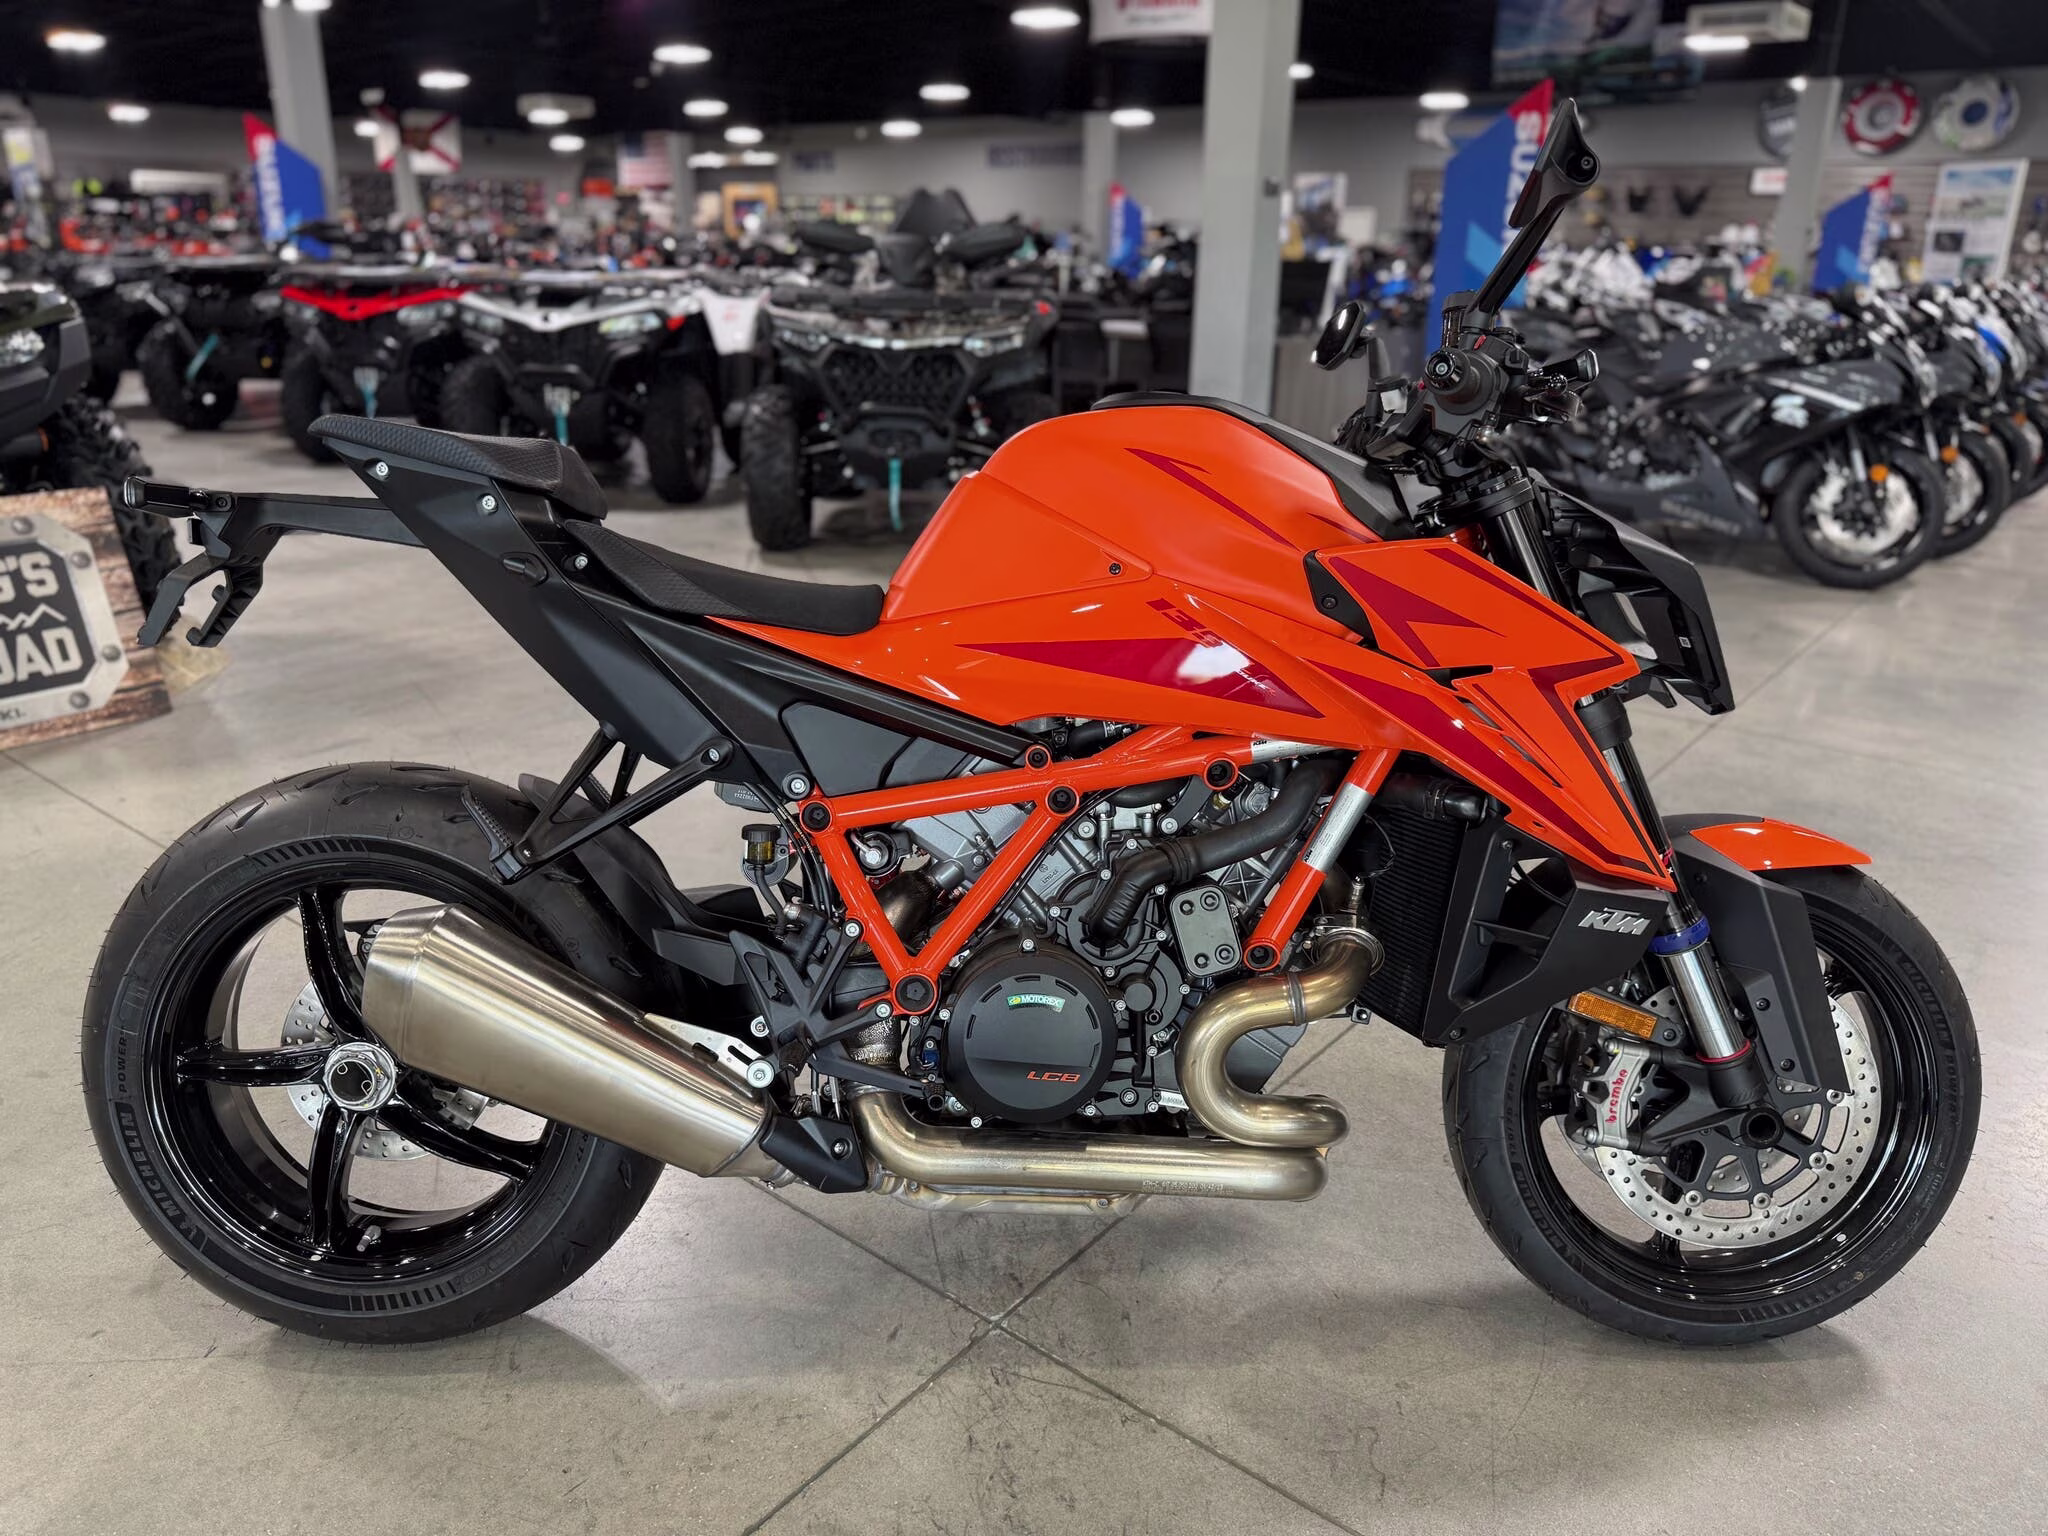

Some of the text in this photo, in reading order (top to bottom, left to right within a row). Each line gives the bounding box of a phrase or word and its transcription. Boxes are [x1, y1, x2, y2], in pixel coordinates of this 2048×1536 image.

[1578, 907, 1651, 935] KTM
[1022, 994, 1059, 1006] MOTOREX
[1027, 1071, 1080, 1082] LC8
[1605, 1069, 1628, 1123] brembo
[117, 1038, 181, 1217] MICHELIN POWER
